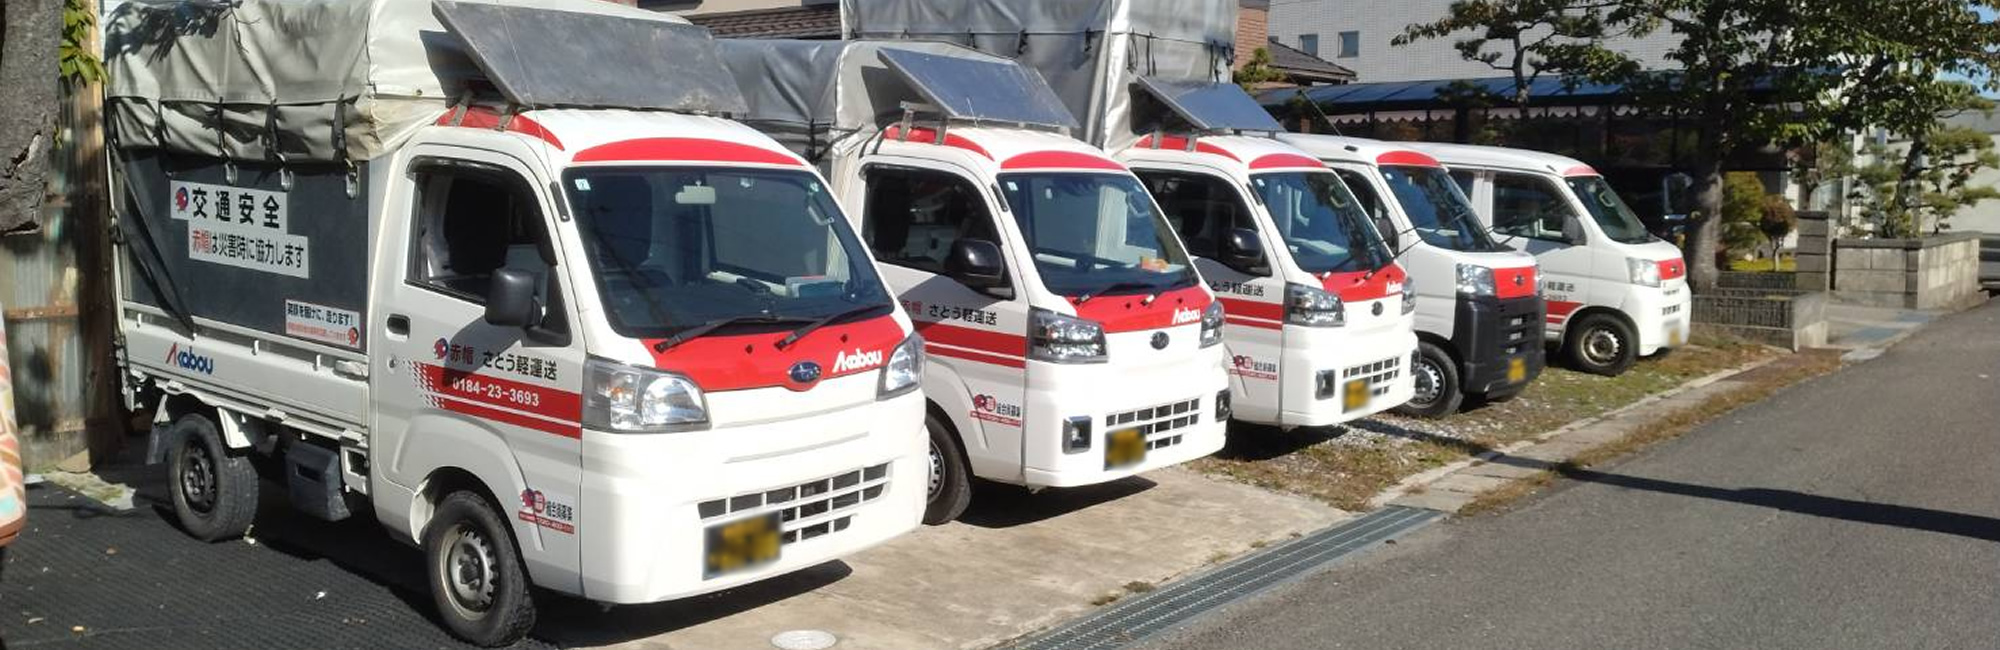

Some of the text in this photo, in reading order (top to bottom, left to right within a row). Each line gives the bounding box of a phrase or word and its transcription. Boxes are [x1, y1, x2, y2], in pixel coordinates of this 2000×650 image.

[192, 187, 279, 229] 交通安全
[483, 350, 557, 380] さとう軽運送
[453, 377, 540, 407] 0184-23-3693
